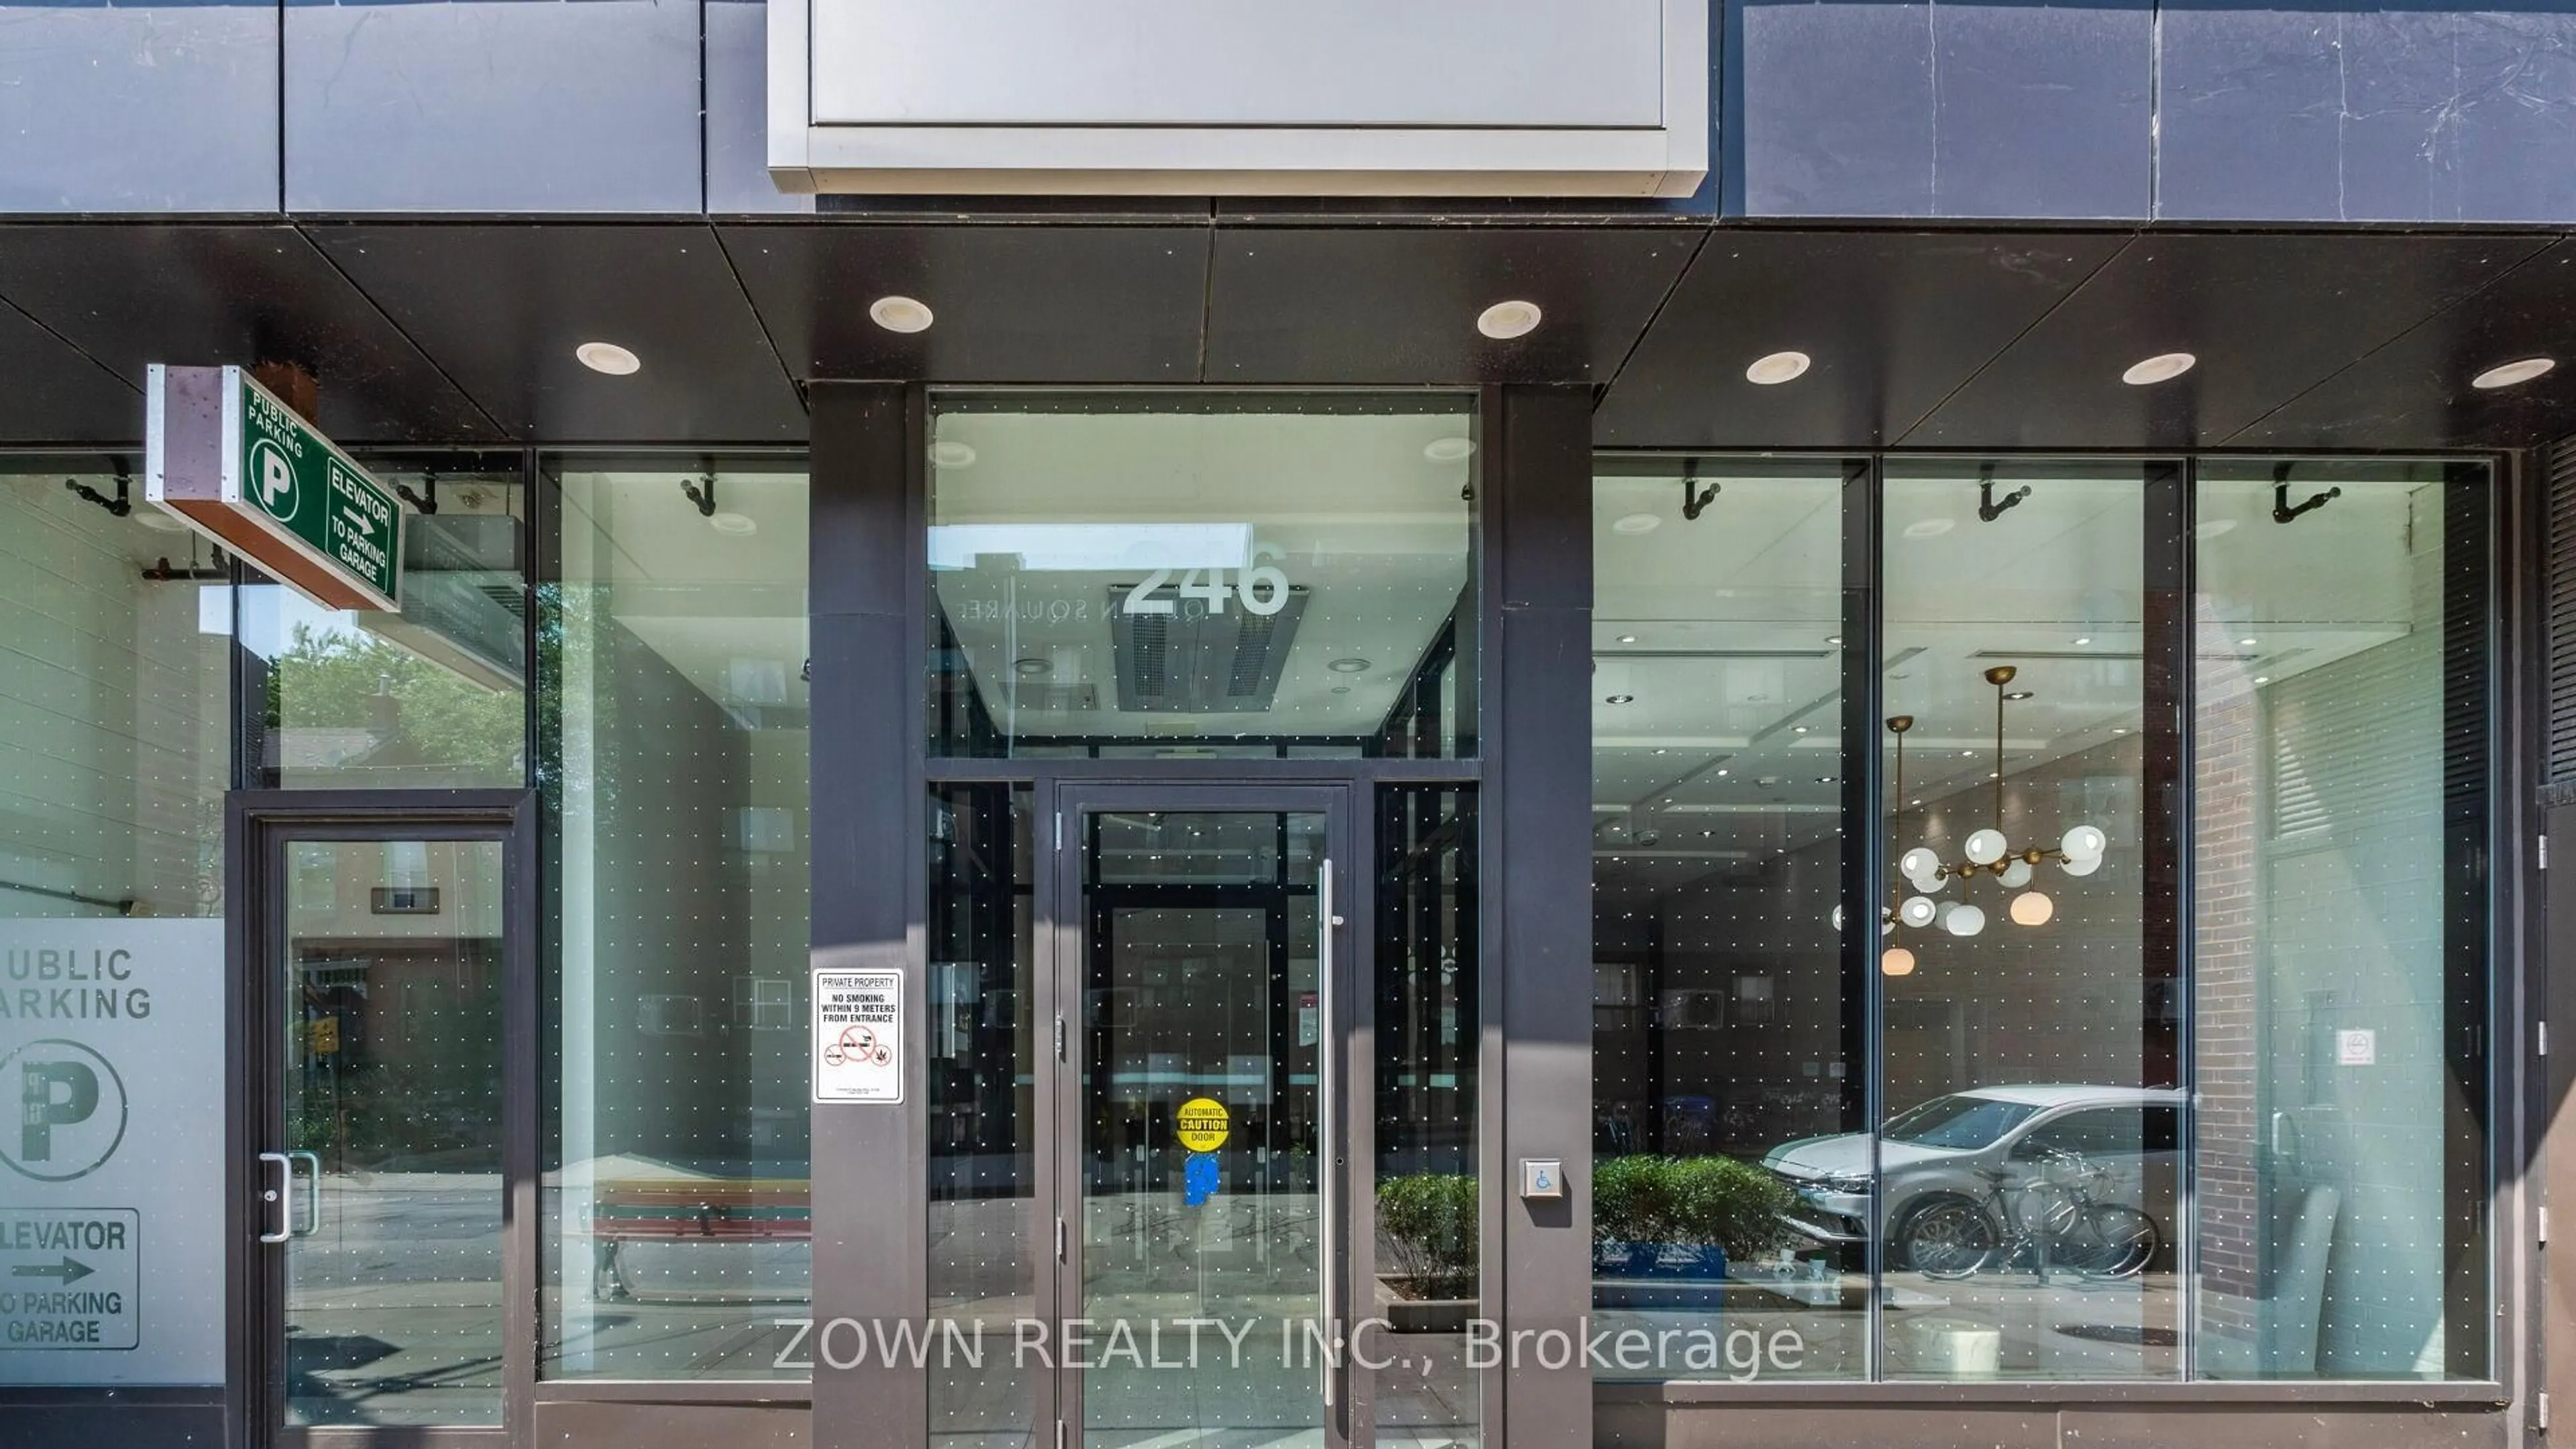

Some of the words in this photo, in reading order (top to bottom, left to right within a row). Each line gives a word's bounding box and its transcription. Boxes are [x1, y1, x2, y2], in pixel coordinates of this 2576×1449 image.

[253, 390, 297, 437] PUBLIC
[249, 405, 303, 458] PARKING
[262, 446, 291, 507] P
[331, 466, 389, 527] ELEVATOR
[331, 515, 345, 537] TO
[346, 527, 386, 569] PARKING
[339, 543, 377, 582] GARAGE
[1123, 540, 1289, 615] 246
[8, 949, 131, 981] UBLIC
[822, 977, 853, 987] PRIVATE
[855, 977, 894, 987] PROPERTY
[0, 987, 150, 1019] RKING
[832, 994, 844, 1003] NO
[846, 994, 885, 1003] SMOKING
[823, 1014, 848, 1022] FROM
[850, 1014, 894, 1022] ENTRANCE
[21, 1061, 99, 1161] P
[1180, 1120, 1228, 1130] CAUTION
[1184, 1108, 1223, 1117] AUTOMATIC
[1191, 1132, 1216, 1141] DOOR
[0, 1221, 125, 1250] LEVATOR
[1, 1292, 15, 1314] O
[24, 1292, 122, 1314] PARKING
[8, 1320, 100, 1342] GARAGE
